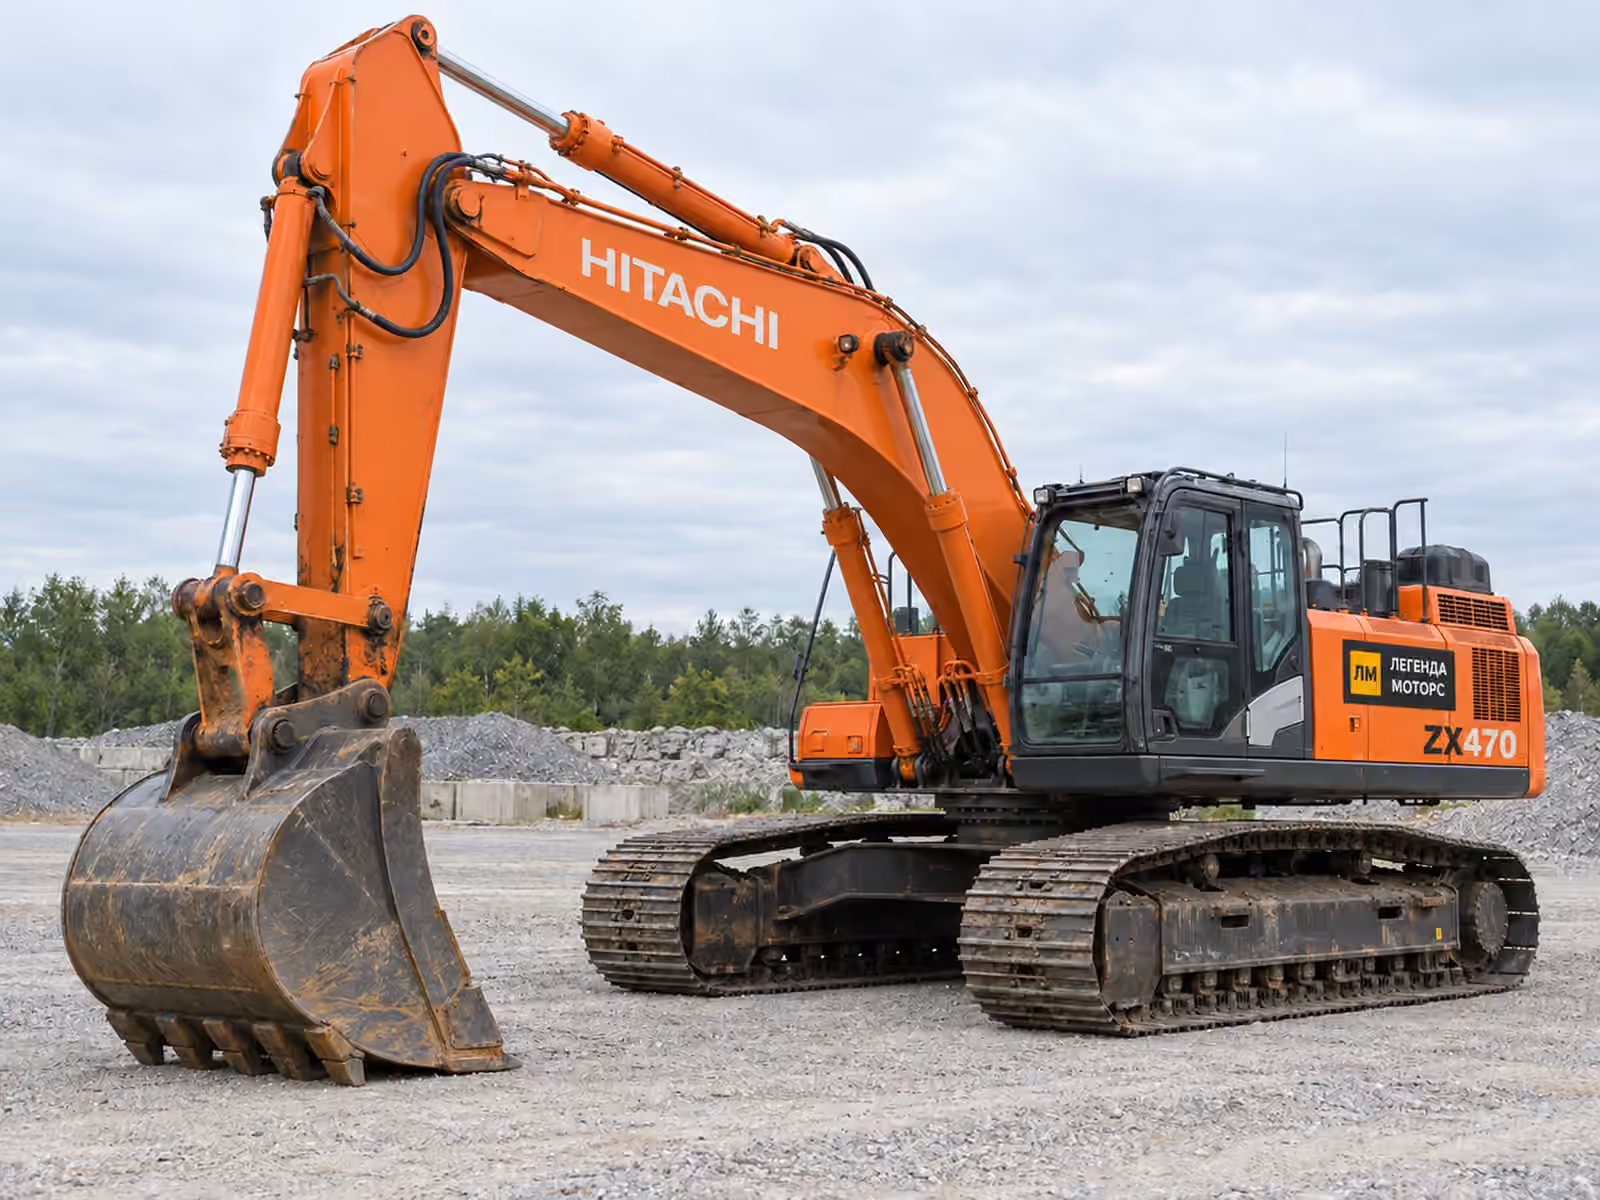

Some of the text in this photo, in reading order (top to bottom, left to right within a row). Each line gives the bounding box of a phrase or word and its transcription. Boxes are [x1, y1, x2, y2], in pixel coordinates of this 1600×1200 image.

[581, 237, 779, 350] HITACHI
[1354, 665, 1377, 681] ЛМ
[1390, 657, 1447, 677] ЛЕГЕНДА
[1391, 679, 1445, 696] МОТОРС
[1424, 725, 1517, 759] ZX470
